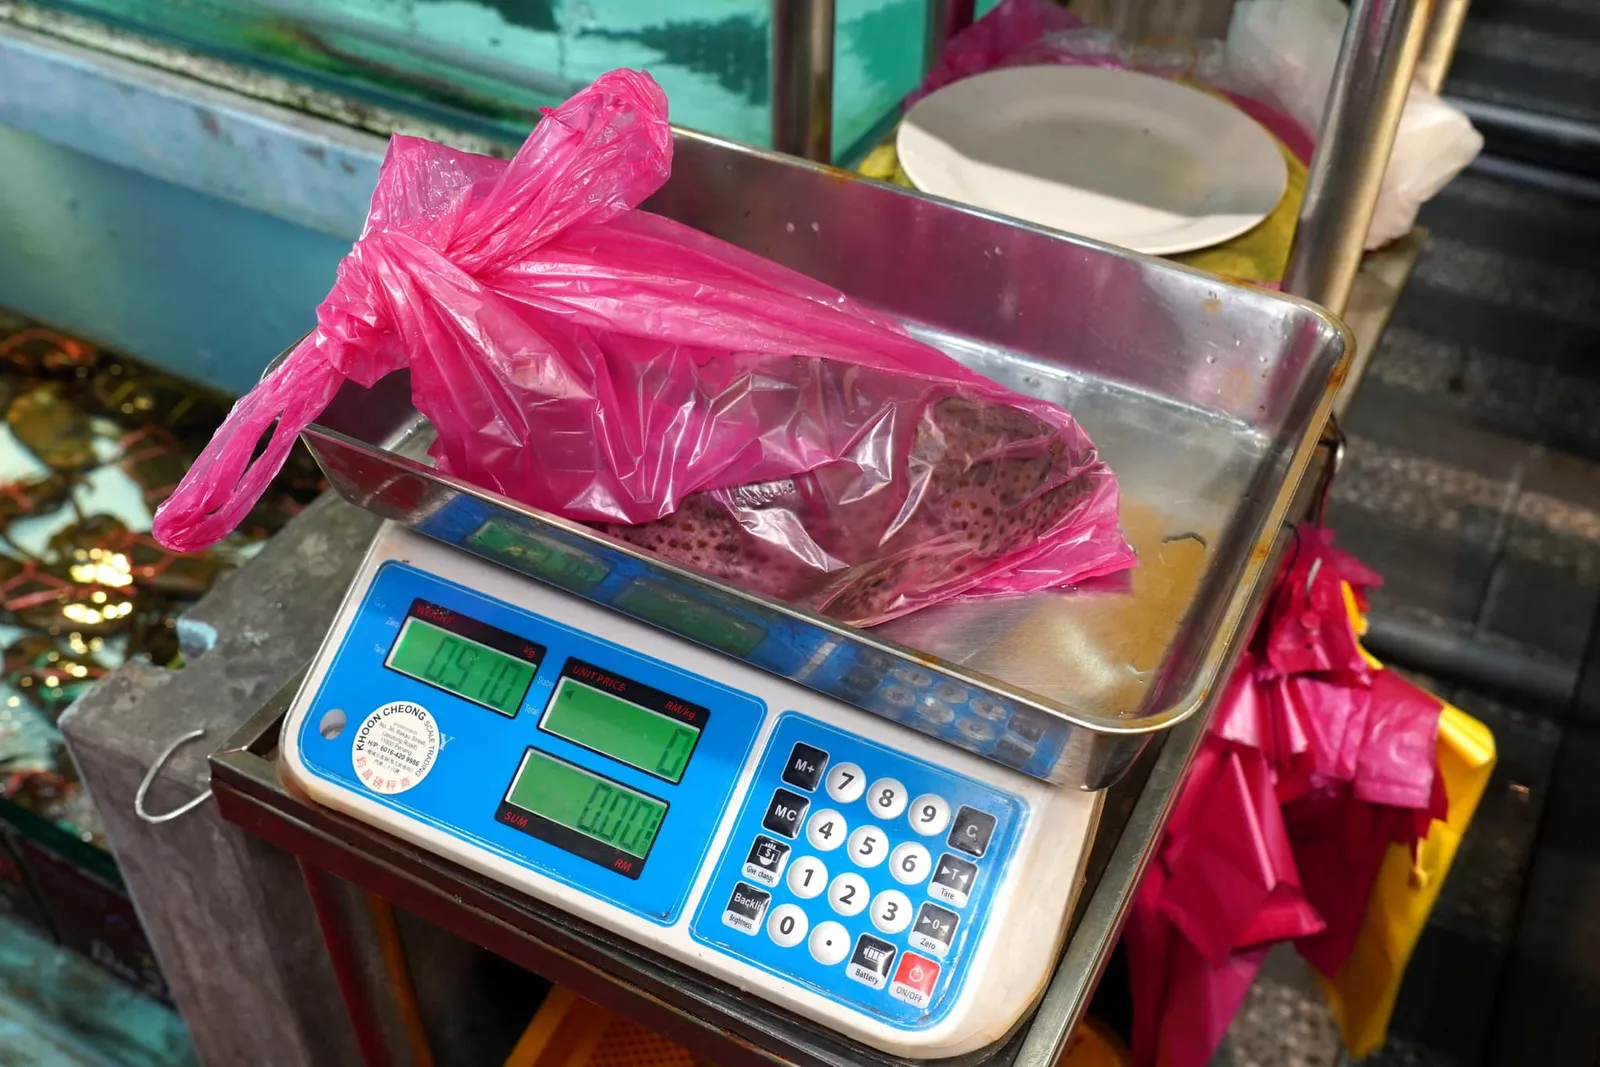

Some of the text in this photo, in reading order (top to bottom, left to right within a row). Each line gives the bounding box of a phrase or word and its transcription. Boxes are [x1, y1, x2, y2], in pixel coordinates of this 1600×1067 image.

[523, 646, 536, 659] kg
[571, 665, 627, 692] UNIT PRICE
[382, 704, 426, 720] CHEONG
[665, 700, 696, 721] RM/kg
[356, 713, 382, 752] KHOON
[423, 720, 436, 743] SCALE
[415, 745, 435, 778] TRADING
[656, 727, 693, 778] 0
[795, 758, 815, 773] M+
[837, 772, 855, 790] 7
[878, 788, 895, 808] 8
[504, 811, 529, 828] SUM
[774, 804, 797, 822] MC
[920, 805, 937, 823] 9
[818, 821, 834, 840] 4
[965, 824, 979, 838] C
[858, 836, 876, 855] 5
[614, 858, 632, 873] RM
[901, 854, 918, 873] 6
[803, 868, 814, 888] 1
[838, 884, 856, 906] 2
[940, 887, 955, 900] Tare
[881, 901, 899, 922] 3
[728, 913, 752, 930] Brightness
[779, 915, 795, 935] 0
[931, 919, 940, 930] 0
[920, 937, 936, 951] Zero
[855, 968, 879, 985] Battery
[895, 985, 923, 1001] ON/OFF
